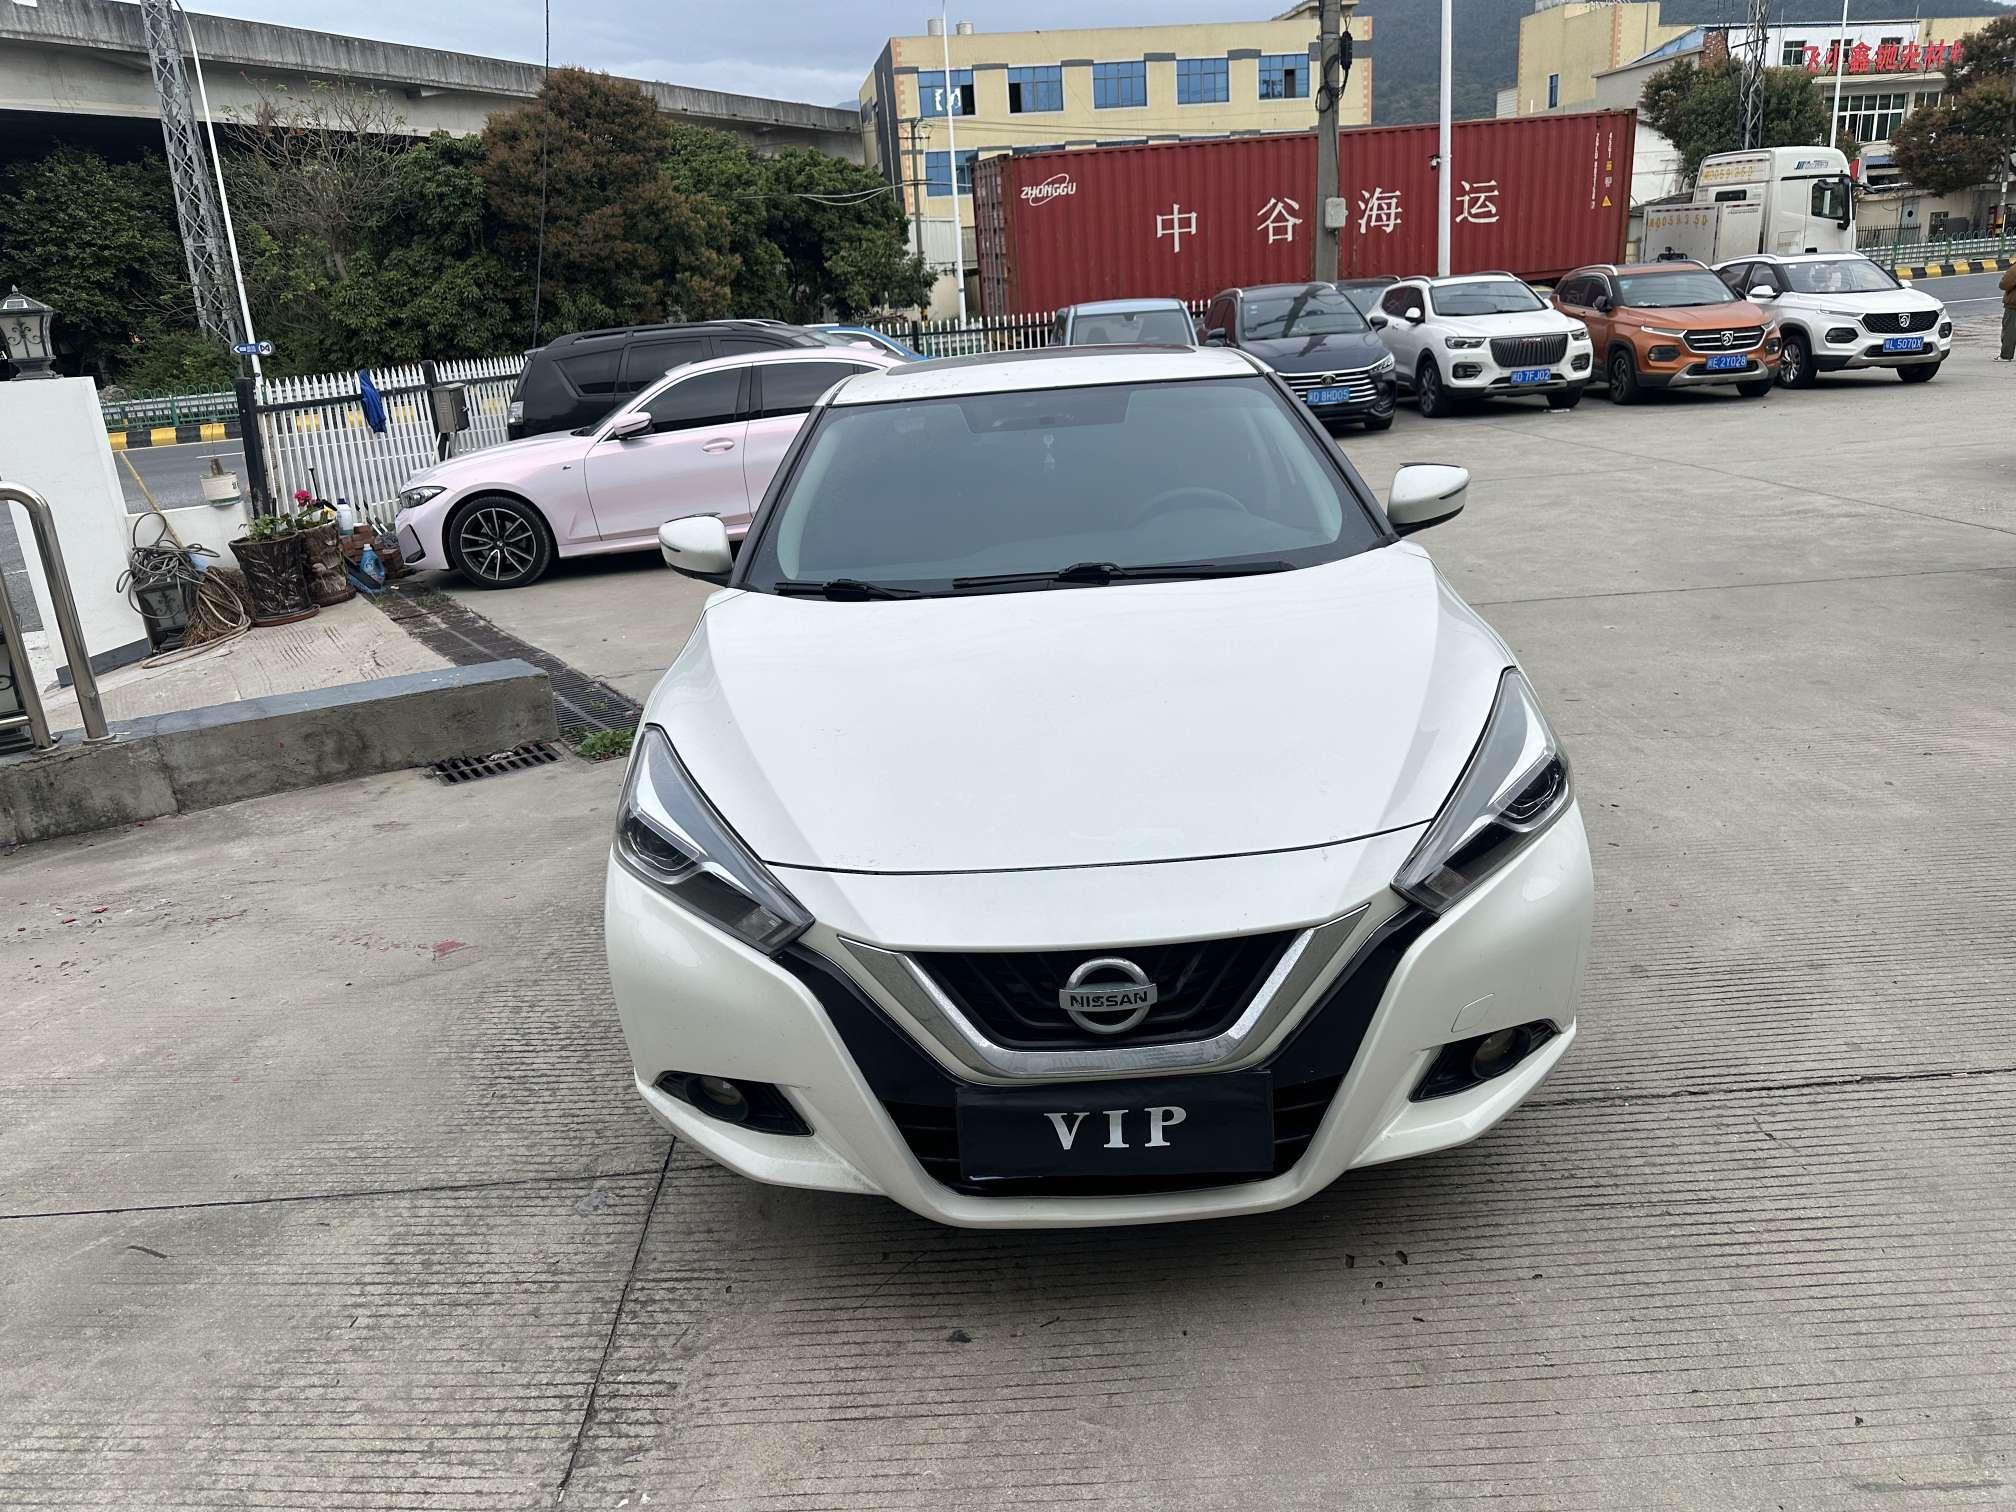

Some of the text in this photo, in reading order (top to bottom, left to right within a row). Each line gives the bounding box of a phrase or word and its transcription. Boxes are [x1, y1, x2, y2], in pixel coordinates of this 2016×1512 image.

[1020, 182, 1076, 199] ZHONGGU
[1156, 179, 1500, 253] 中谷海运
[1069, 990, 1148, 1008] NISSAN
[1043, 1105, 1187, 1150] VIP
